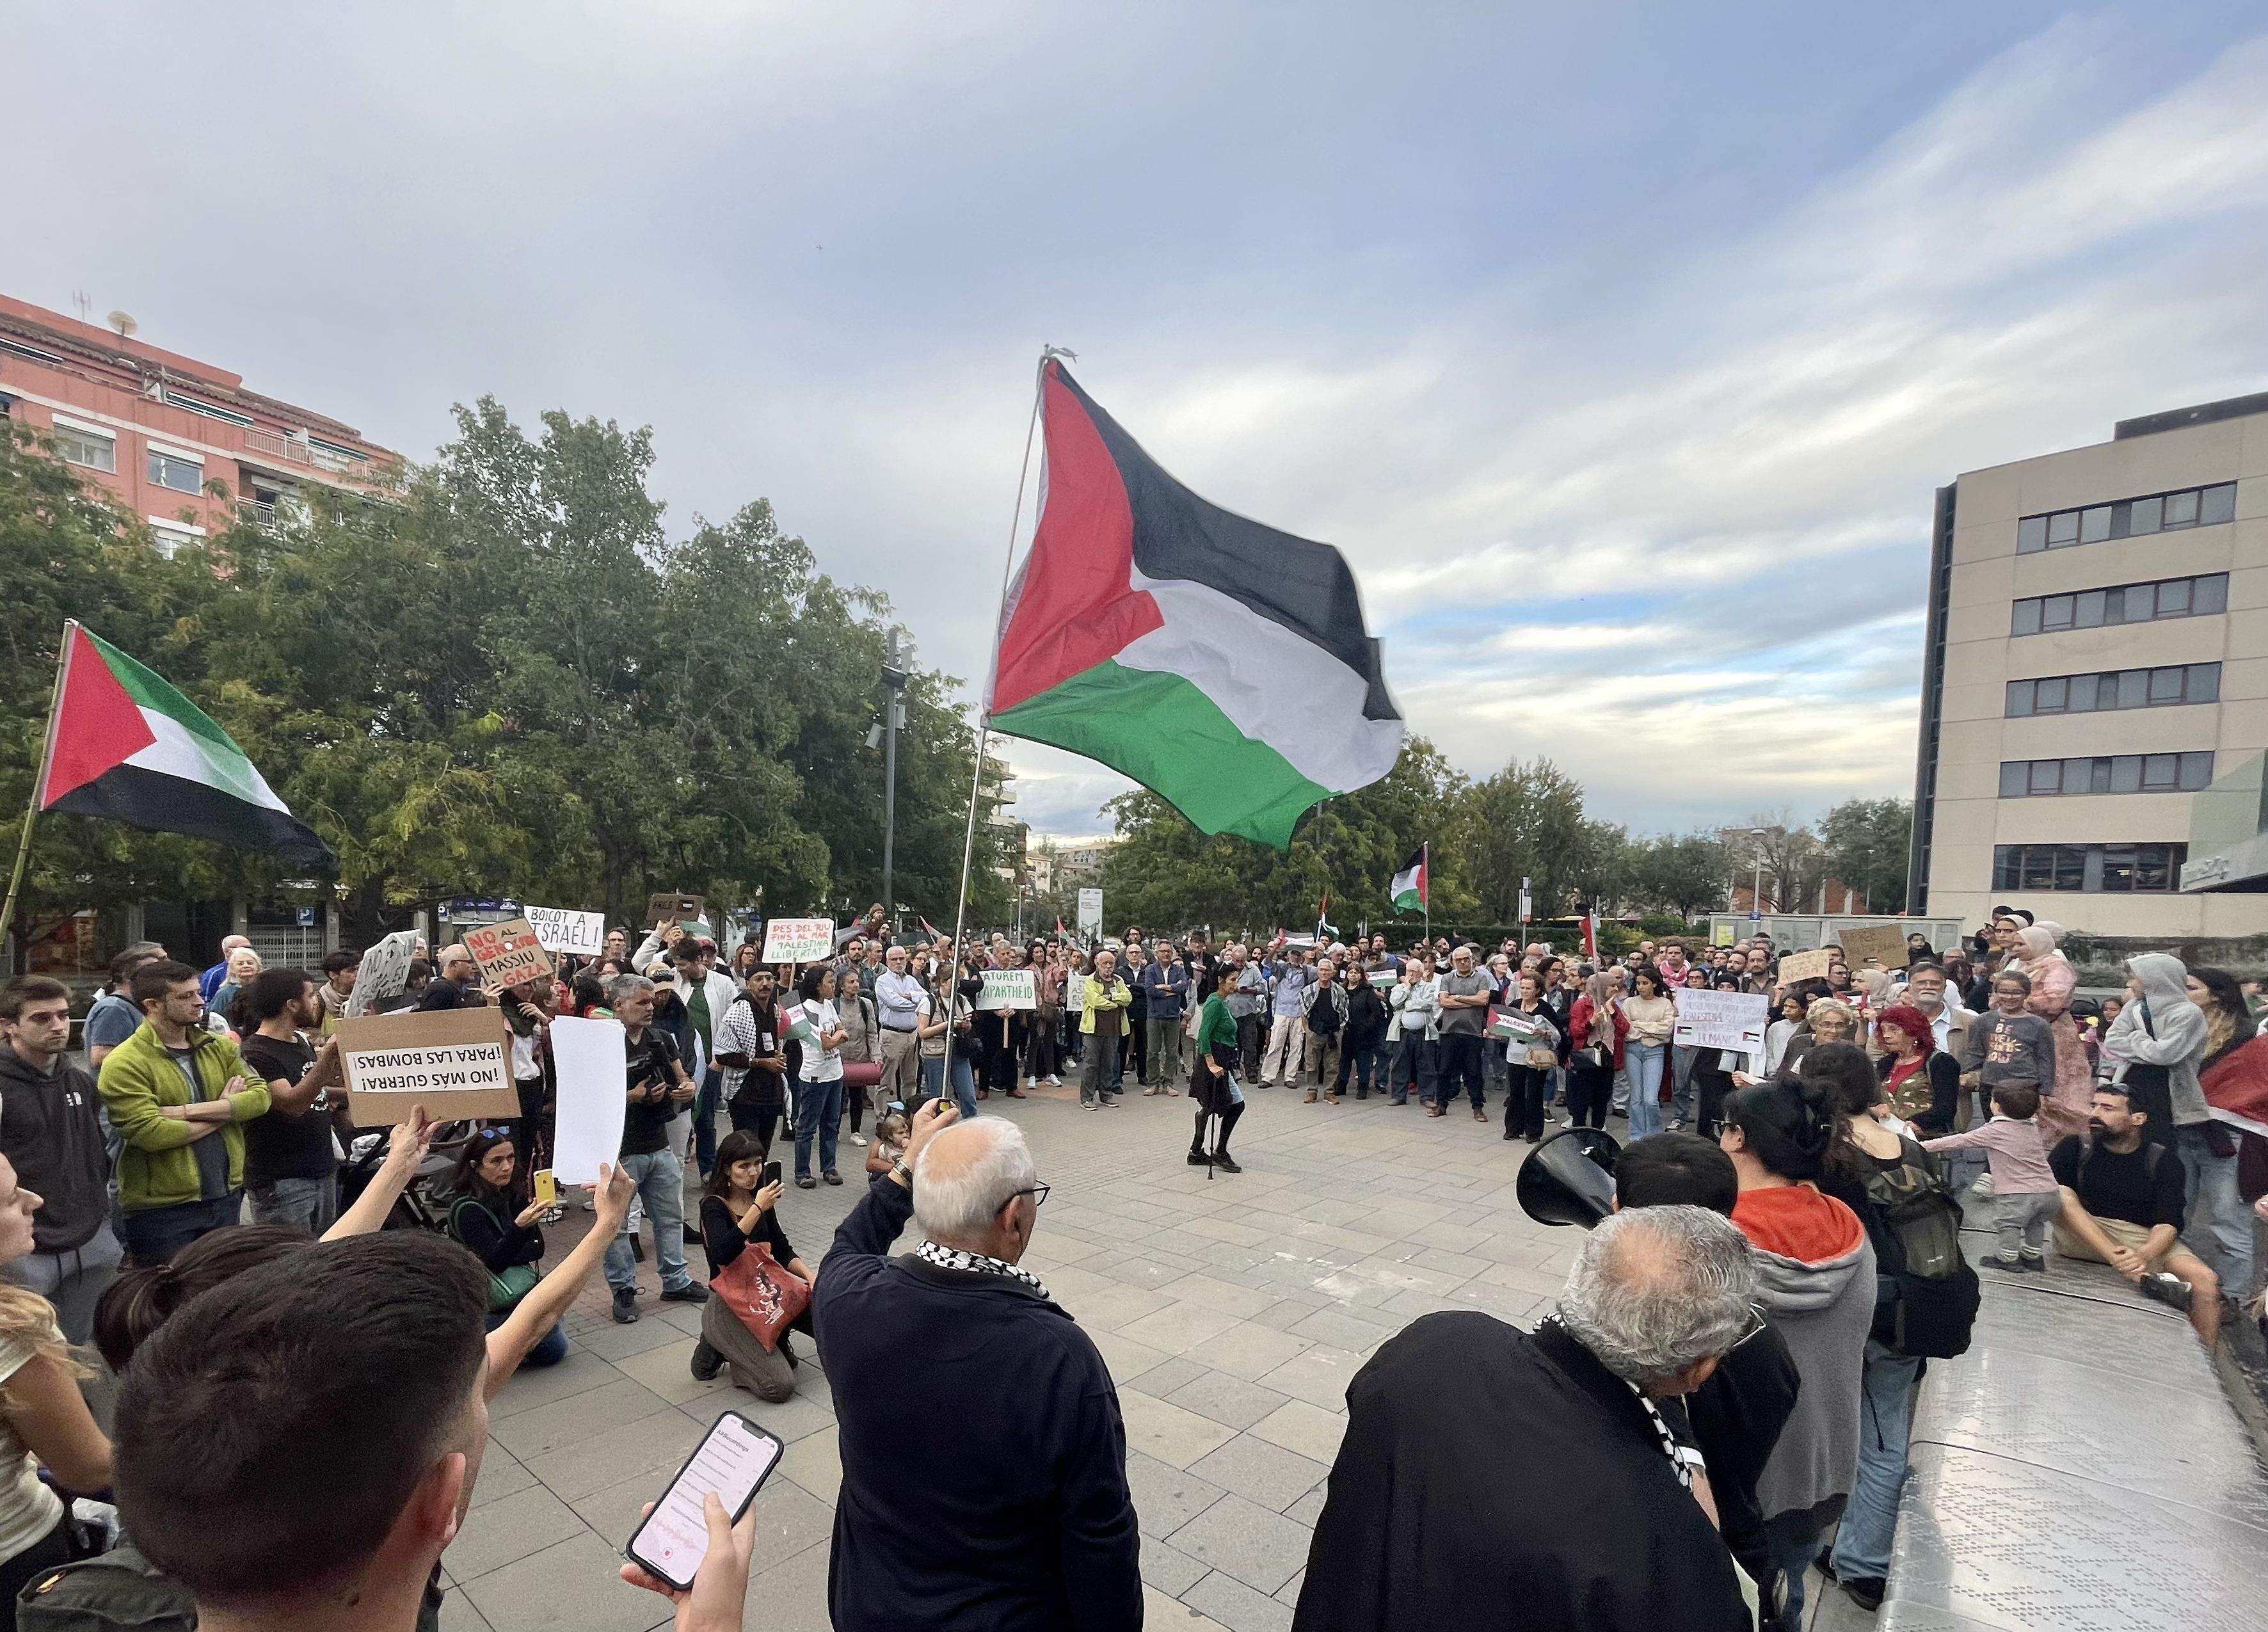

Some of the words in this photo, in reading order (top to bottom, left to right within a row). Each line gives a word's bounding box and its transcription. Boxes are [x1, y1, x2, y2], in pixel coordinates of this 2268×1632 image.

[531, 908, 569, 924] BOICOT
[576, 913, 585, 925] A
[773, 925, 792, 933] DES
[795, 924, 811, 932] DEL
[467, 931, 496, 948] NO
[778, 940, 829, 949] PALESTINA
[771, 948, 824, 959] LLIBERTAT
[483, 950, 534, 975] MASSIU
[503, 963, 546, 986] GAZA
[984, 972, 1024, 982] ATUREM
[427, 1051, 453, 1064] LAS
[456, 1046, 501, 1062] ¡PARA
[362, 1075, 427, 1091] GUERRA!
[433, 1071, 466, 1089] MÁS
[470, 1068, 499, 1084] ¡NO
